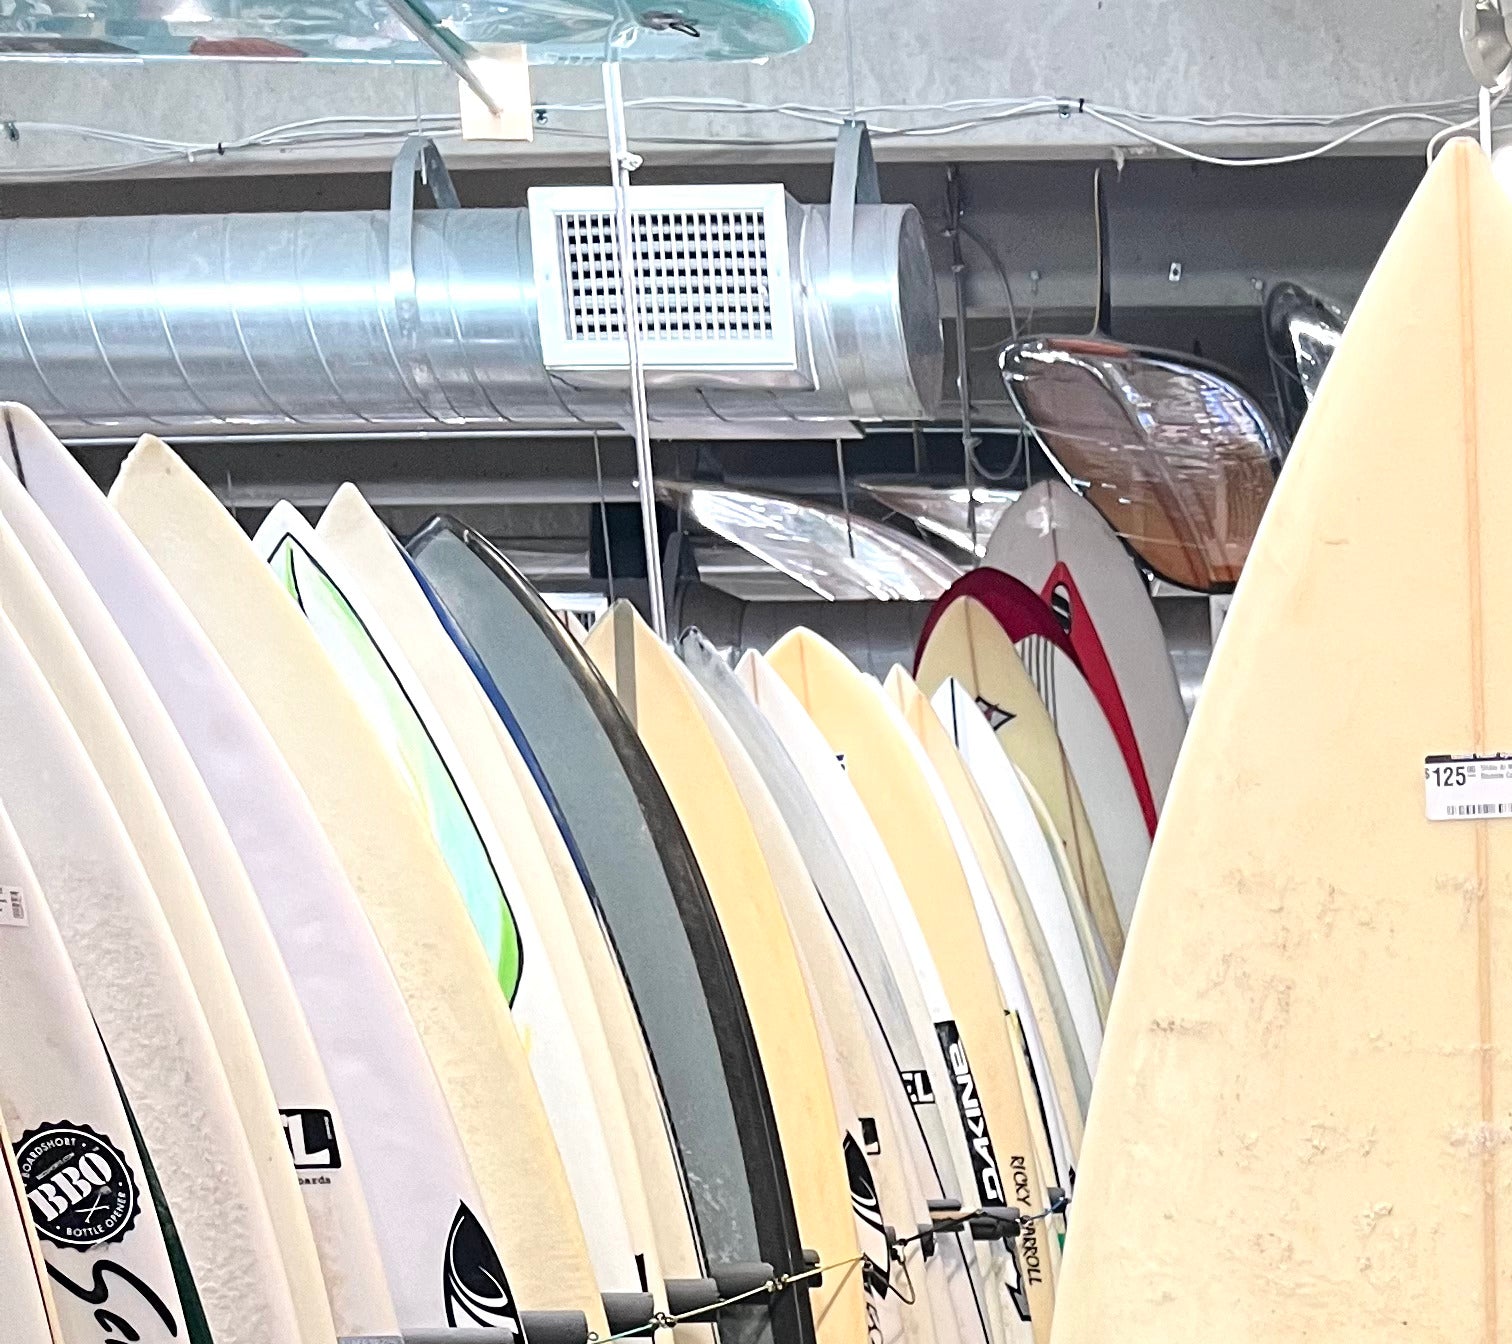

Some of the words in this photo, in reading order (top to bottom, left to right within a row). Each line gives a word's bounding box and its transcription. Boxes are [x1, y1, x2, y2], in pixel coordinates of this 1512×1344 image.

[949, 1040, 1004, 1206] DAKINE
[27, 1152, 112, 1222] BBO
[1011, 1155, 1032, 1207] RICKY
[66, 1225, 105, 1238] BOTTLE
[105, 1191, 127, 1228] OPENER
